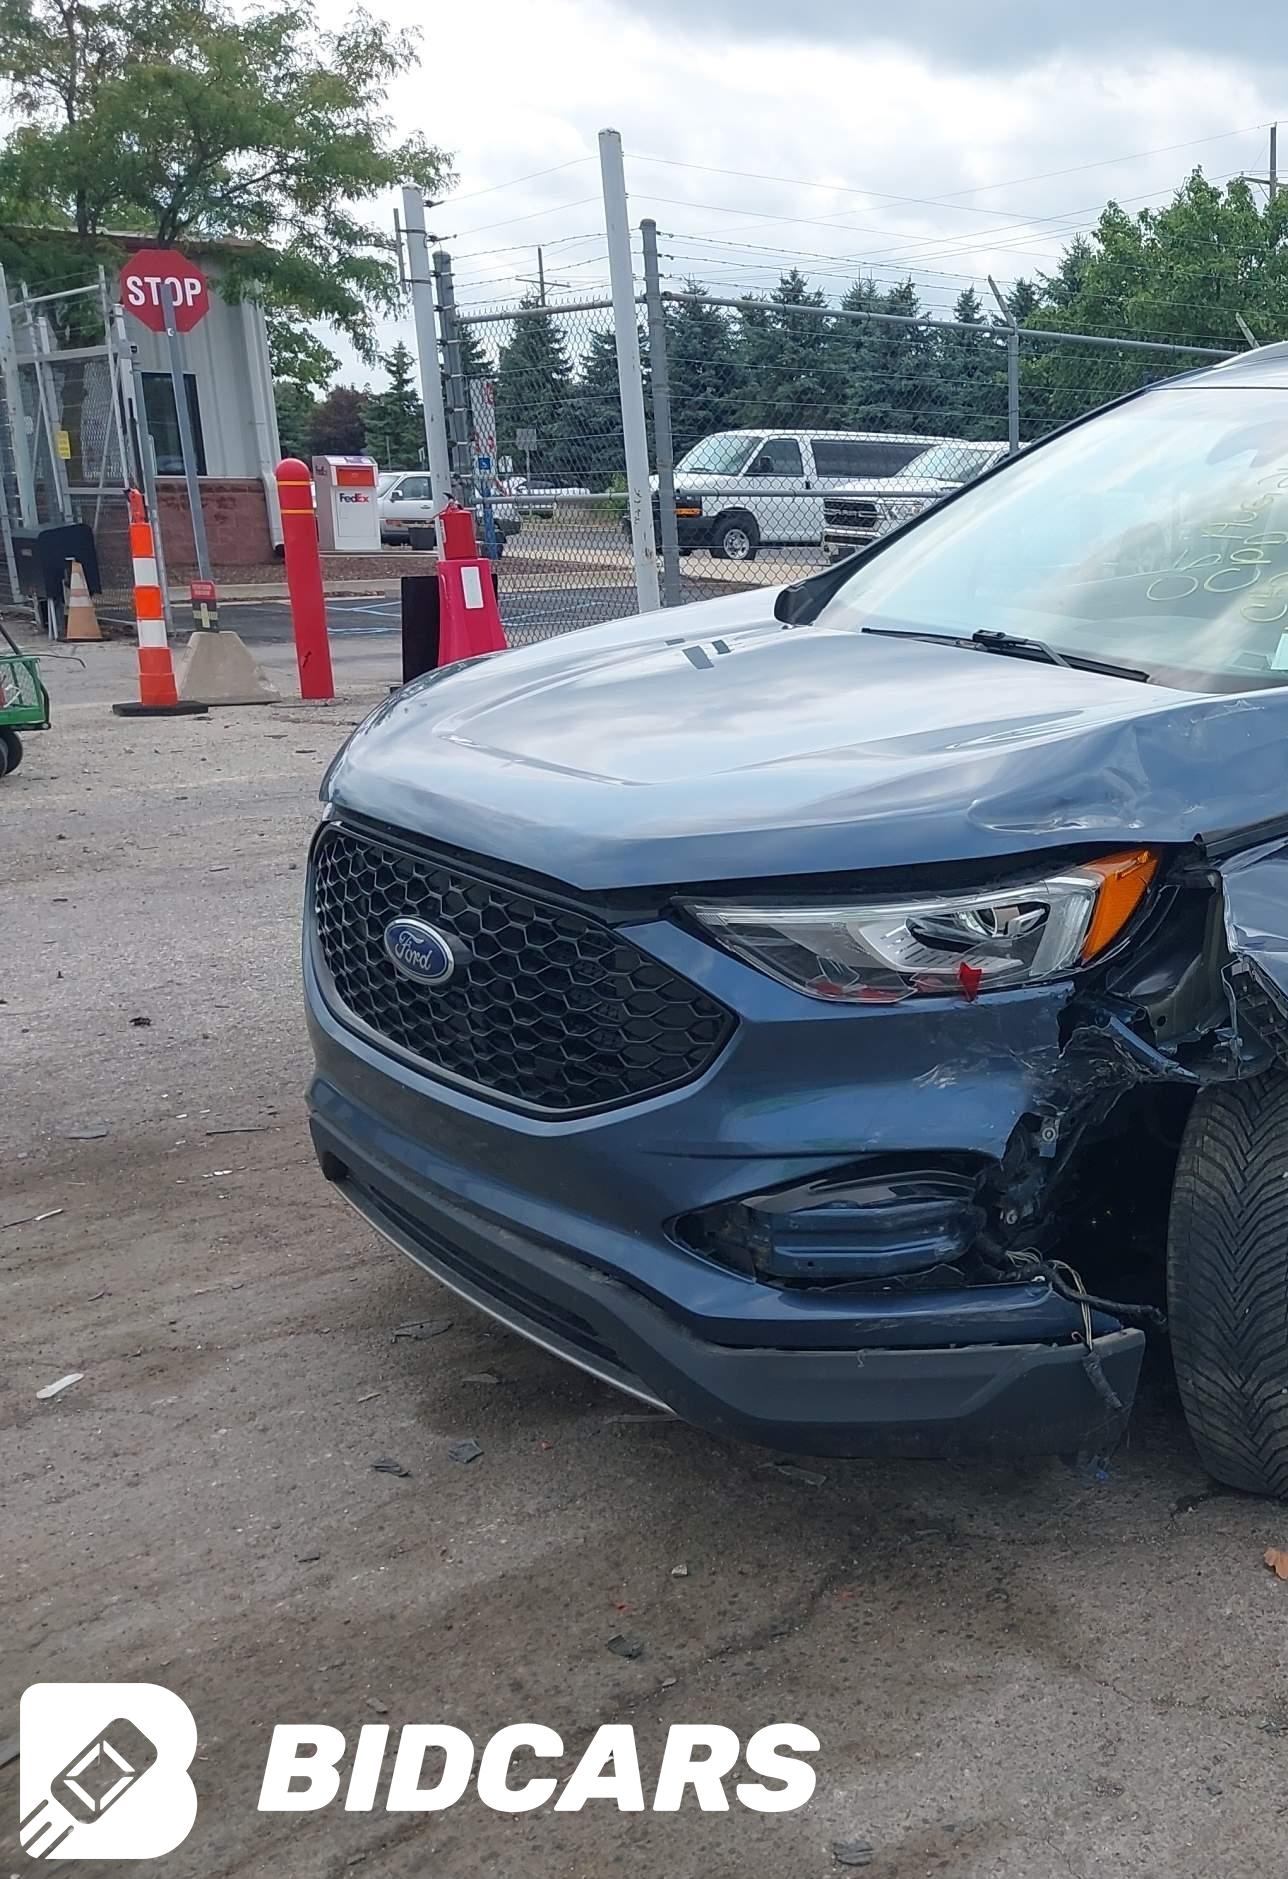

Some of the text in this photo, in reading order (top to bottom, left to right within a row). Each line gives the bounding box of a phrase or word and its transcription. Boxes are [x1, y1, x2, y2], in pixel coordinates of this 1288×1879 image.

[126, 275, 202, 307] STOP
[339, 492, 369, 504] FedEx
[394, 931, 433, 971] Ford
